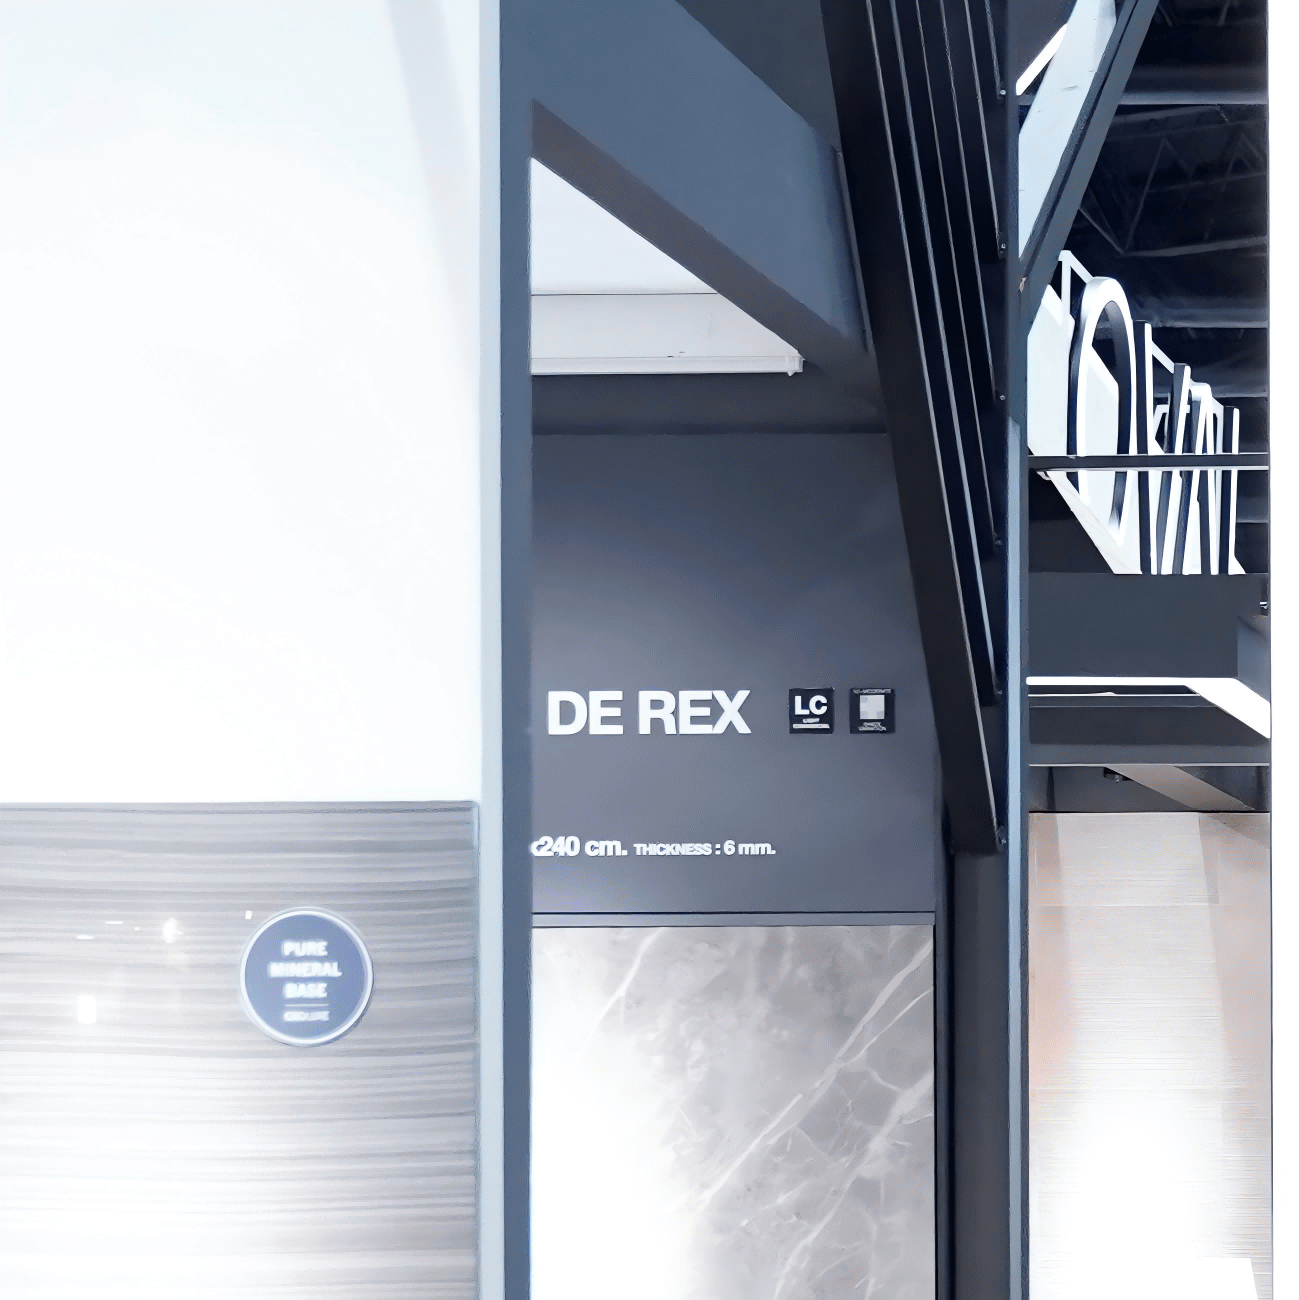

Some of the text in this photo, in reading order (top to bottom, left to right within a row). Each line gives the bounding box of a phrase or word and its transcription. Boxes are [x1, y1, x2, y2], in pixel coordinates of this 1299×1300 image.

[548, 689, 752, 735] DE REX
[794, 694, 828, 716] LC
[584, 839, 629, 857] cm.
[633, 841, 713, 857] THICKNESS
[723, 839, 736, 856] 6
[738, 842, 776, 856] mm.
[282, 940, 329, 957] PURE
[269, 961, 343, 978] MINERAL
[284, 982, 328, 999] BASE
